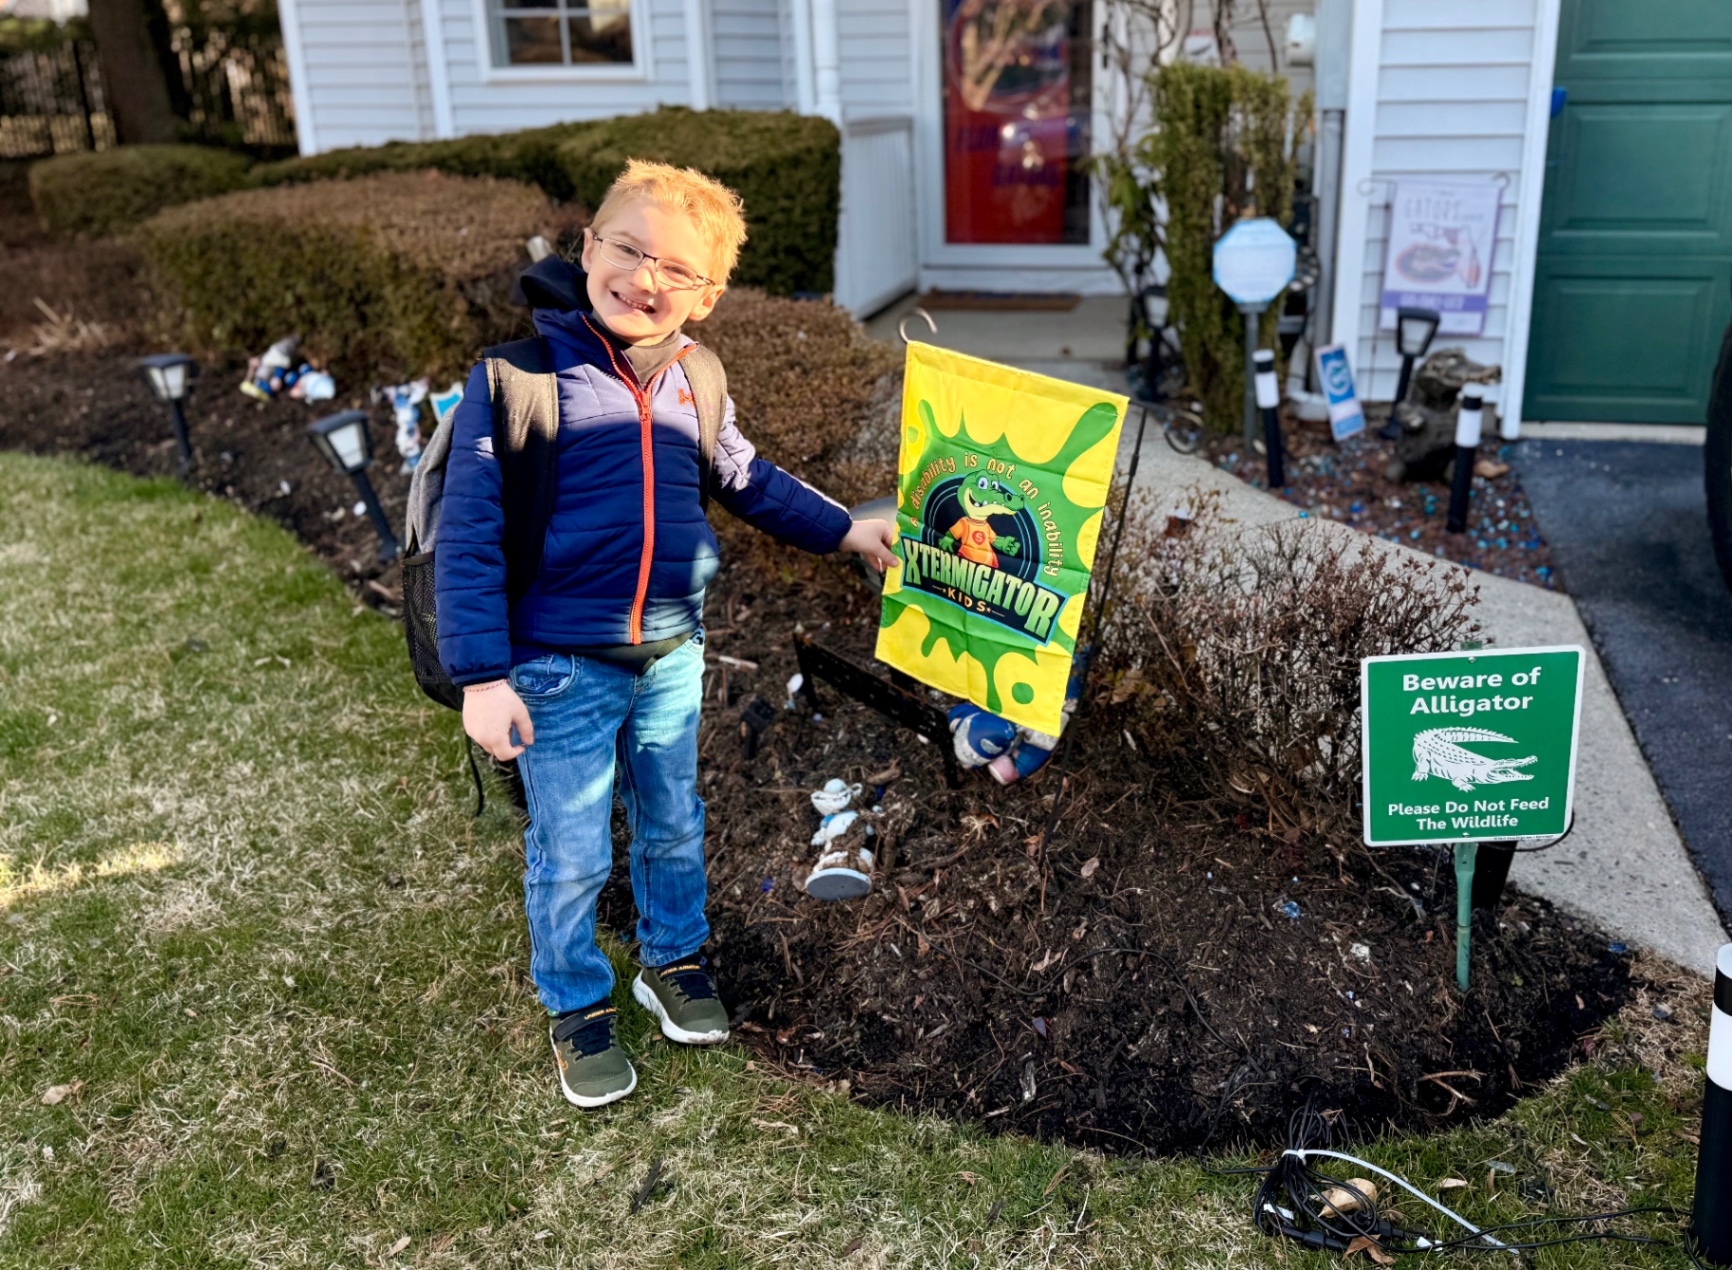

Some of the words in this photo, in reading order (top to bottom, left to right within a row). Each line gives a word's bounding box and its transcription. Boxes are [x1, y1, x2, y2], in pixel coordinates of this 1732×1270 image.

[910, 456, 956, 510] disability
[964, 451, 978, 468] is
[987, 458, 1016, 480] not
[1019, 479, 1039, 500] an
[1037, 501, 1063, 577] inability
[903, 538, 1060, 639] XTERMIGATOR
[947, 587, 986, 613] KIDS
[1403, 674, 1503, 691] Beware
[1511, 667, 1542, 686] of
[1409, 695, 1534, 717] Alligator
[1388, 802, 1440, 815] Please
[1445, 801, 1469, 813] Do
[1473, 799, 1504, 812] Not
[1510, 797, 1550, 810] Feed
[1416, 817, 1446, 830] The
[1451, 814, 1519, 829] Wildlife
